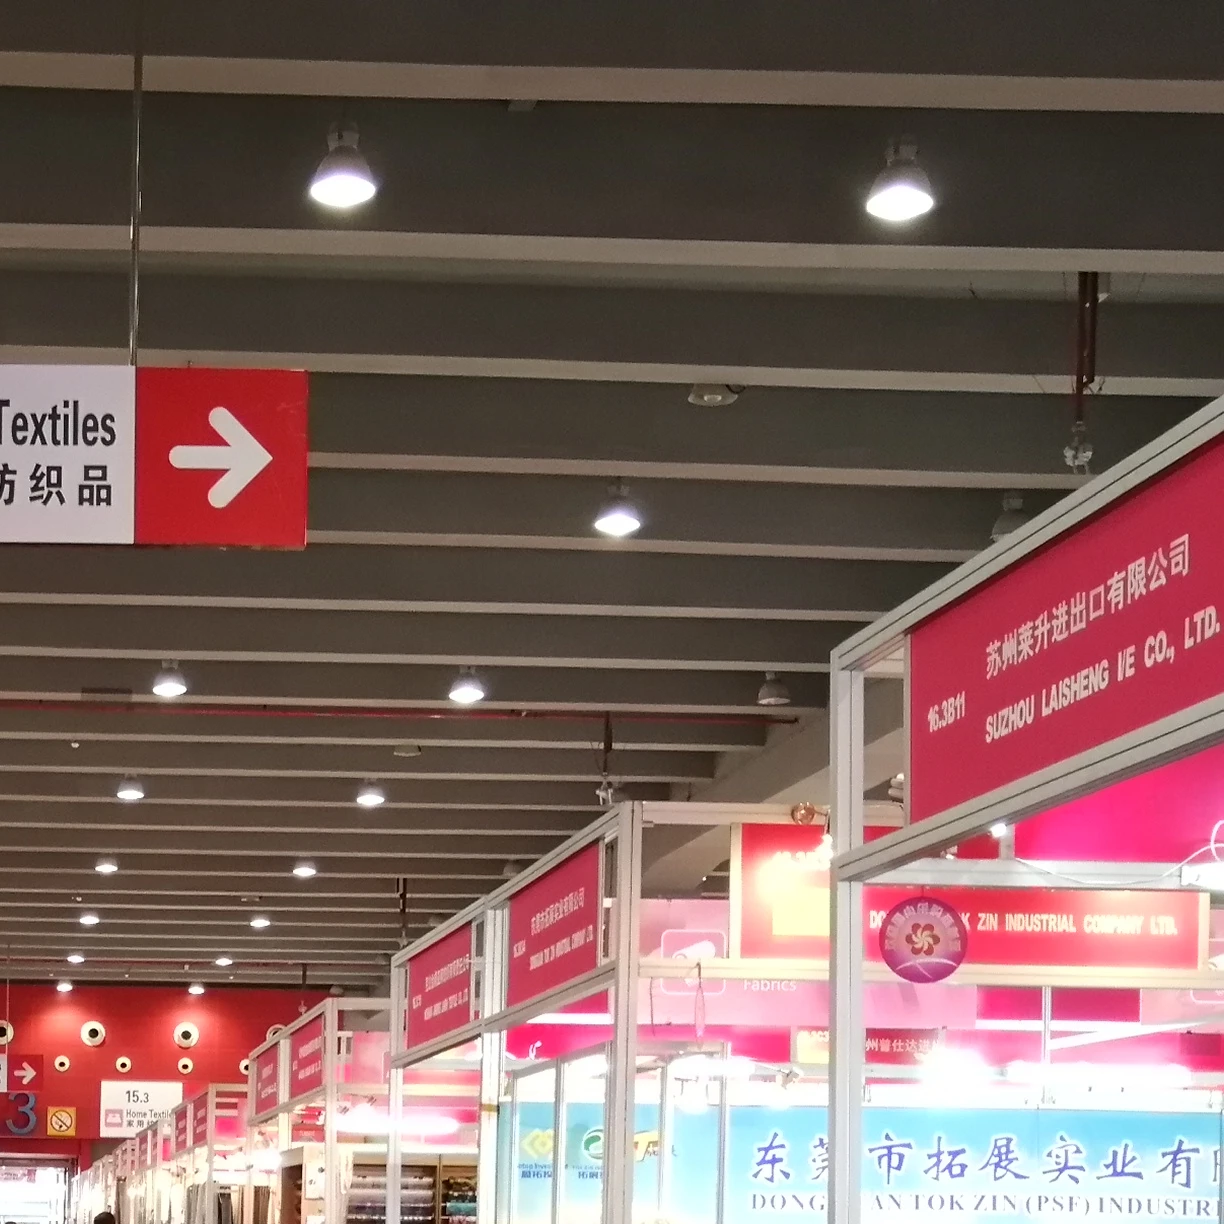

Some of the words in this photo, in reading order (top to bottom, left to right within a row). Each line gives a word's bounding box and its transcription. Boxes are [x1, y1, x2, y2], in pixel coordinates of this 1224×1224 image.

[985, 533, 1190, 680] 苏州莱升进出口有限公司
[985, 694, 1035, 744] SUZHOU
[1041, 658, 1109, 718] LAISHENG
[1184, 605, 1221, 650] LTD.
[977, 913, 998, 931] ZIN
[1005, 913, 1077, 934] INDUSTRIAL
[1083, 915, 1145, 935] COMPANY
[125, 1090, 150, 1104] 15.3
[126, 1109, 147, 1119] Home
[752, 1193, 902, 1211] DONGAN
